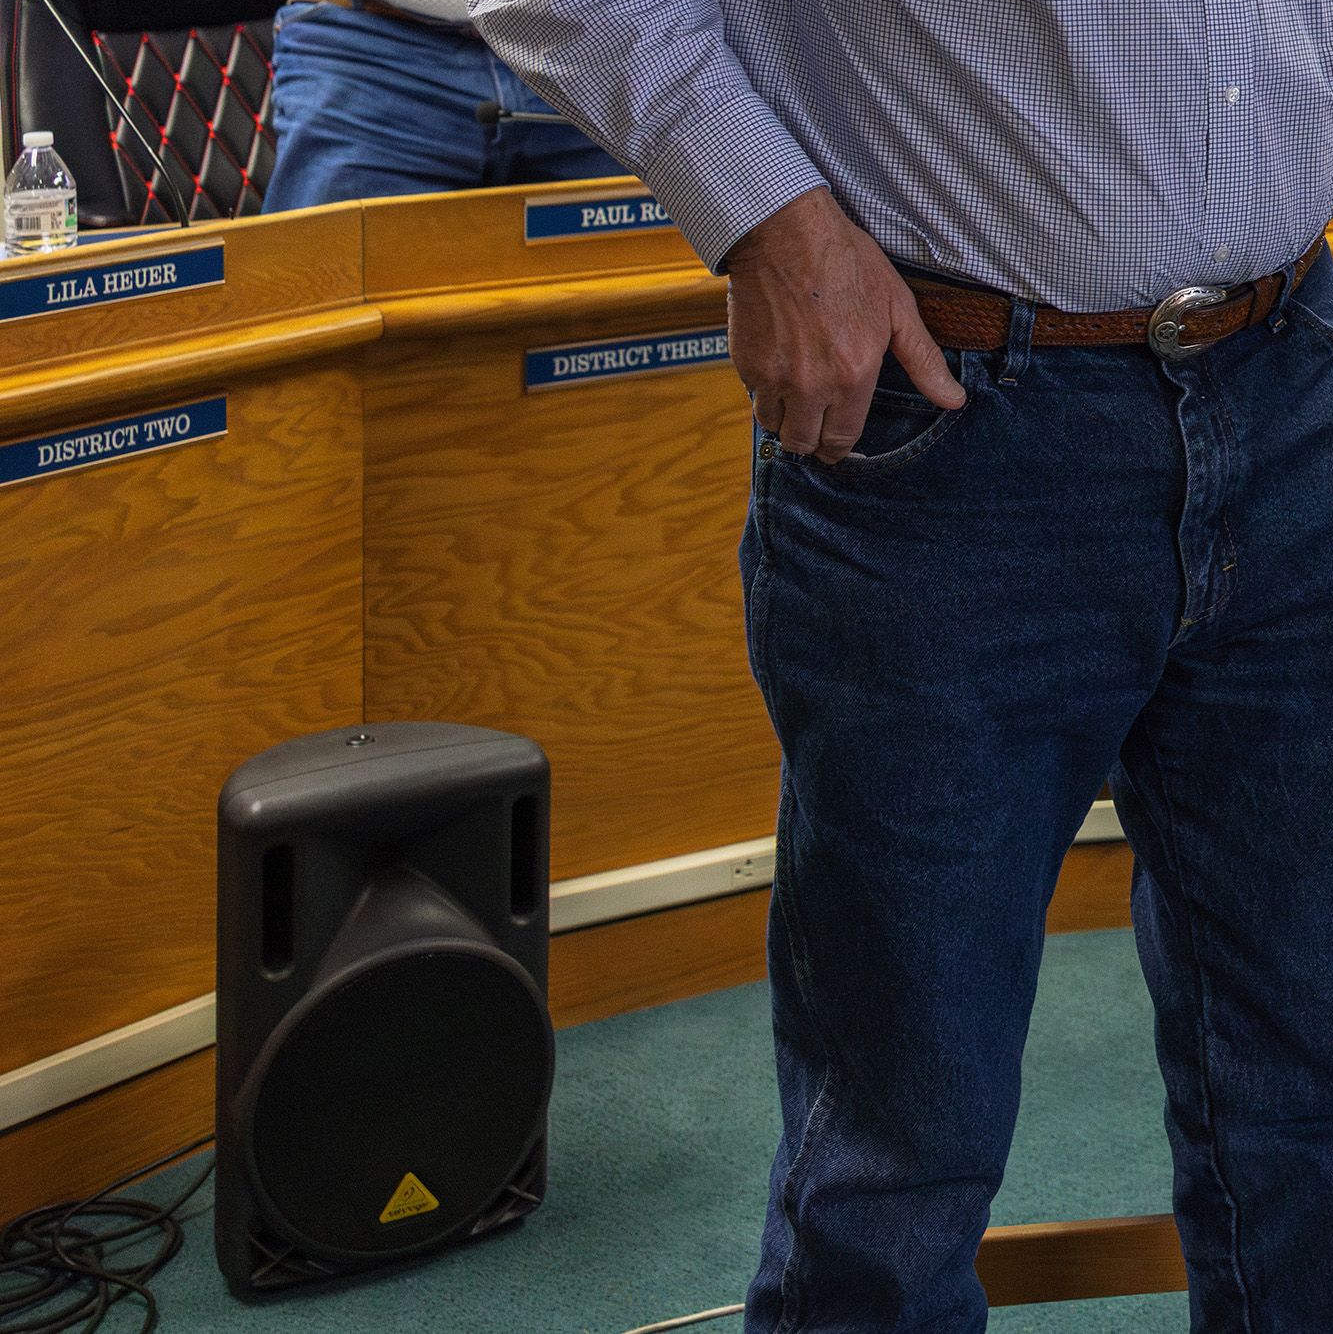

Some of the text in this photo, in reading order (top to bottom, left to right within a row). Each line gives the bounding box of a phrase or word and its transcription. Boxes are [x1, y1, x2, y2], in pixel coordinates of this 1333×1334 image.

[581, 202, 671, 228] PAUL RO
[46, 262, 178, 304] LILA HEUER
[553, 335, 729, 376] DISTRICT THREE
[37, 413, 191, 466] DISTRICT TWO
